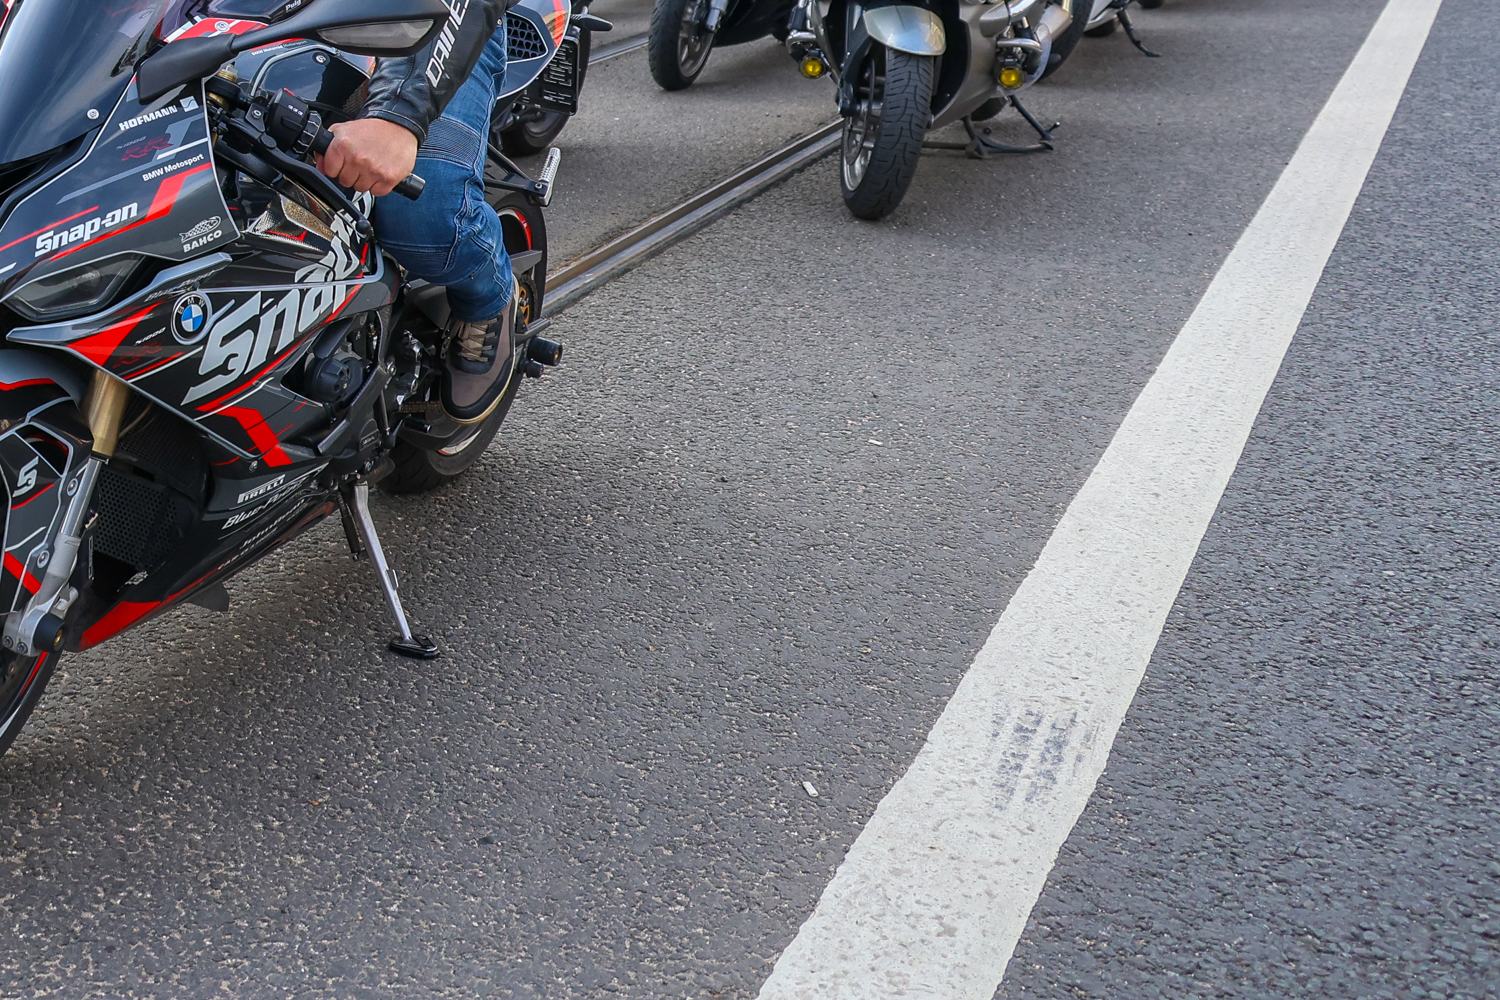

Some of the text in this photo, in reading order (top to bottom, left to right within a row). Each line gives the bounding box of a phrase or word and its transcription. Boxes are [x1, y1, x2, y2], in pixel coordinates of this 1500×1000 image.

[118, 104, 178, 131] HOFMANN
[142, 153, 205, 182] BMW Motorsport
[34, 202, 139, 258] Snap-on
[182, 229, 223, 253] BAHCO
[237, 473, 286, 504] PIRELLI
